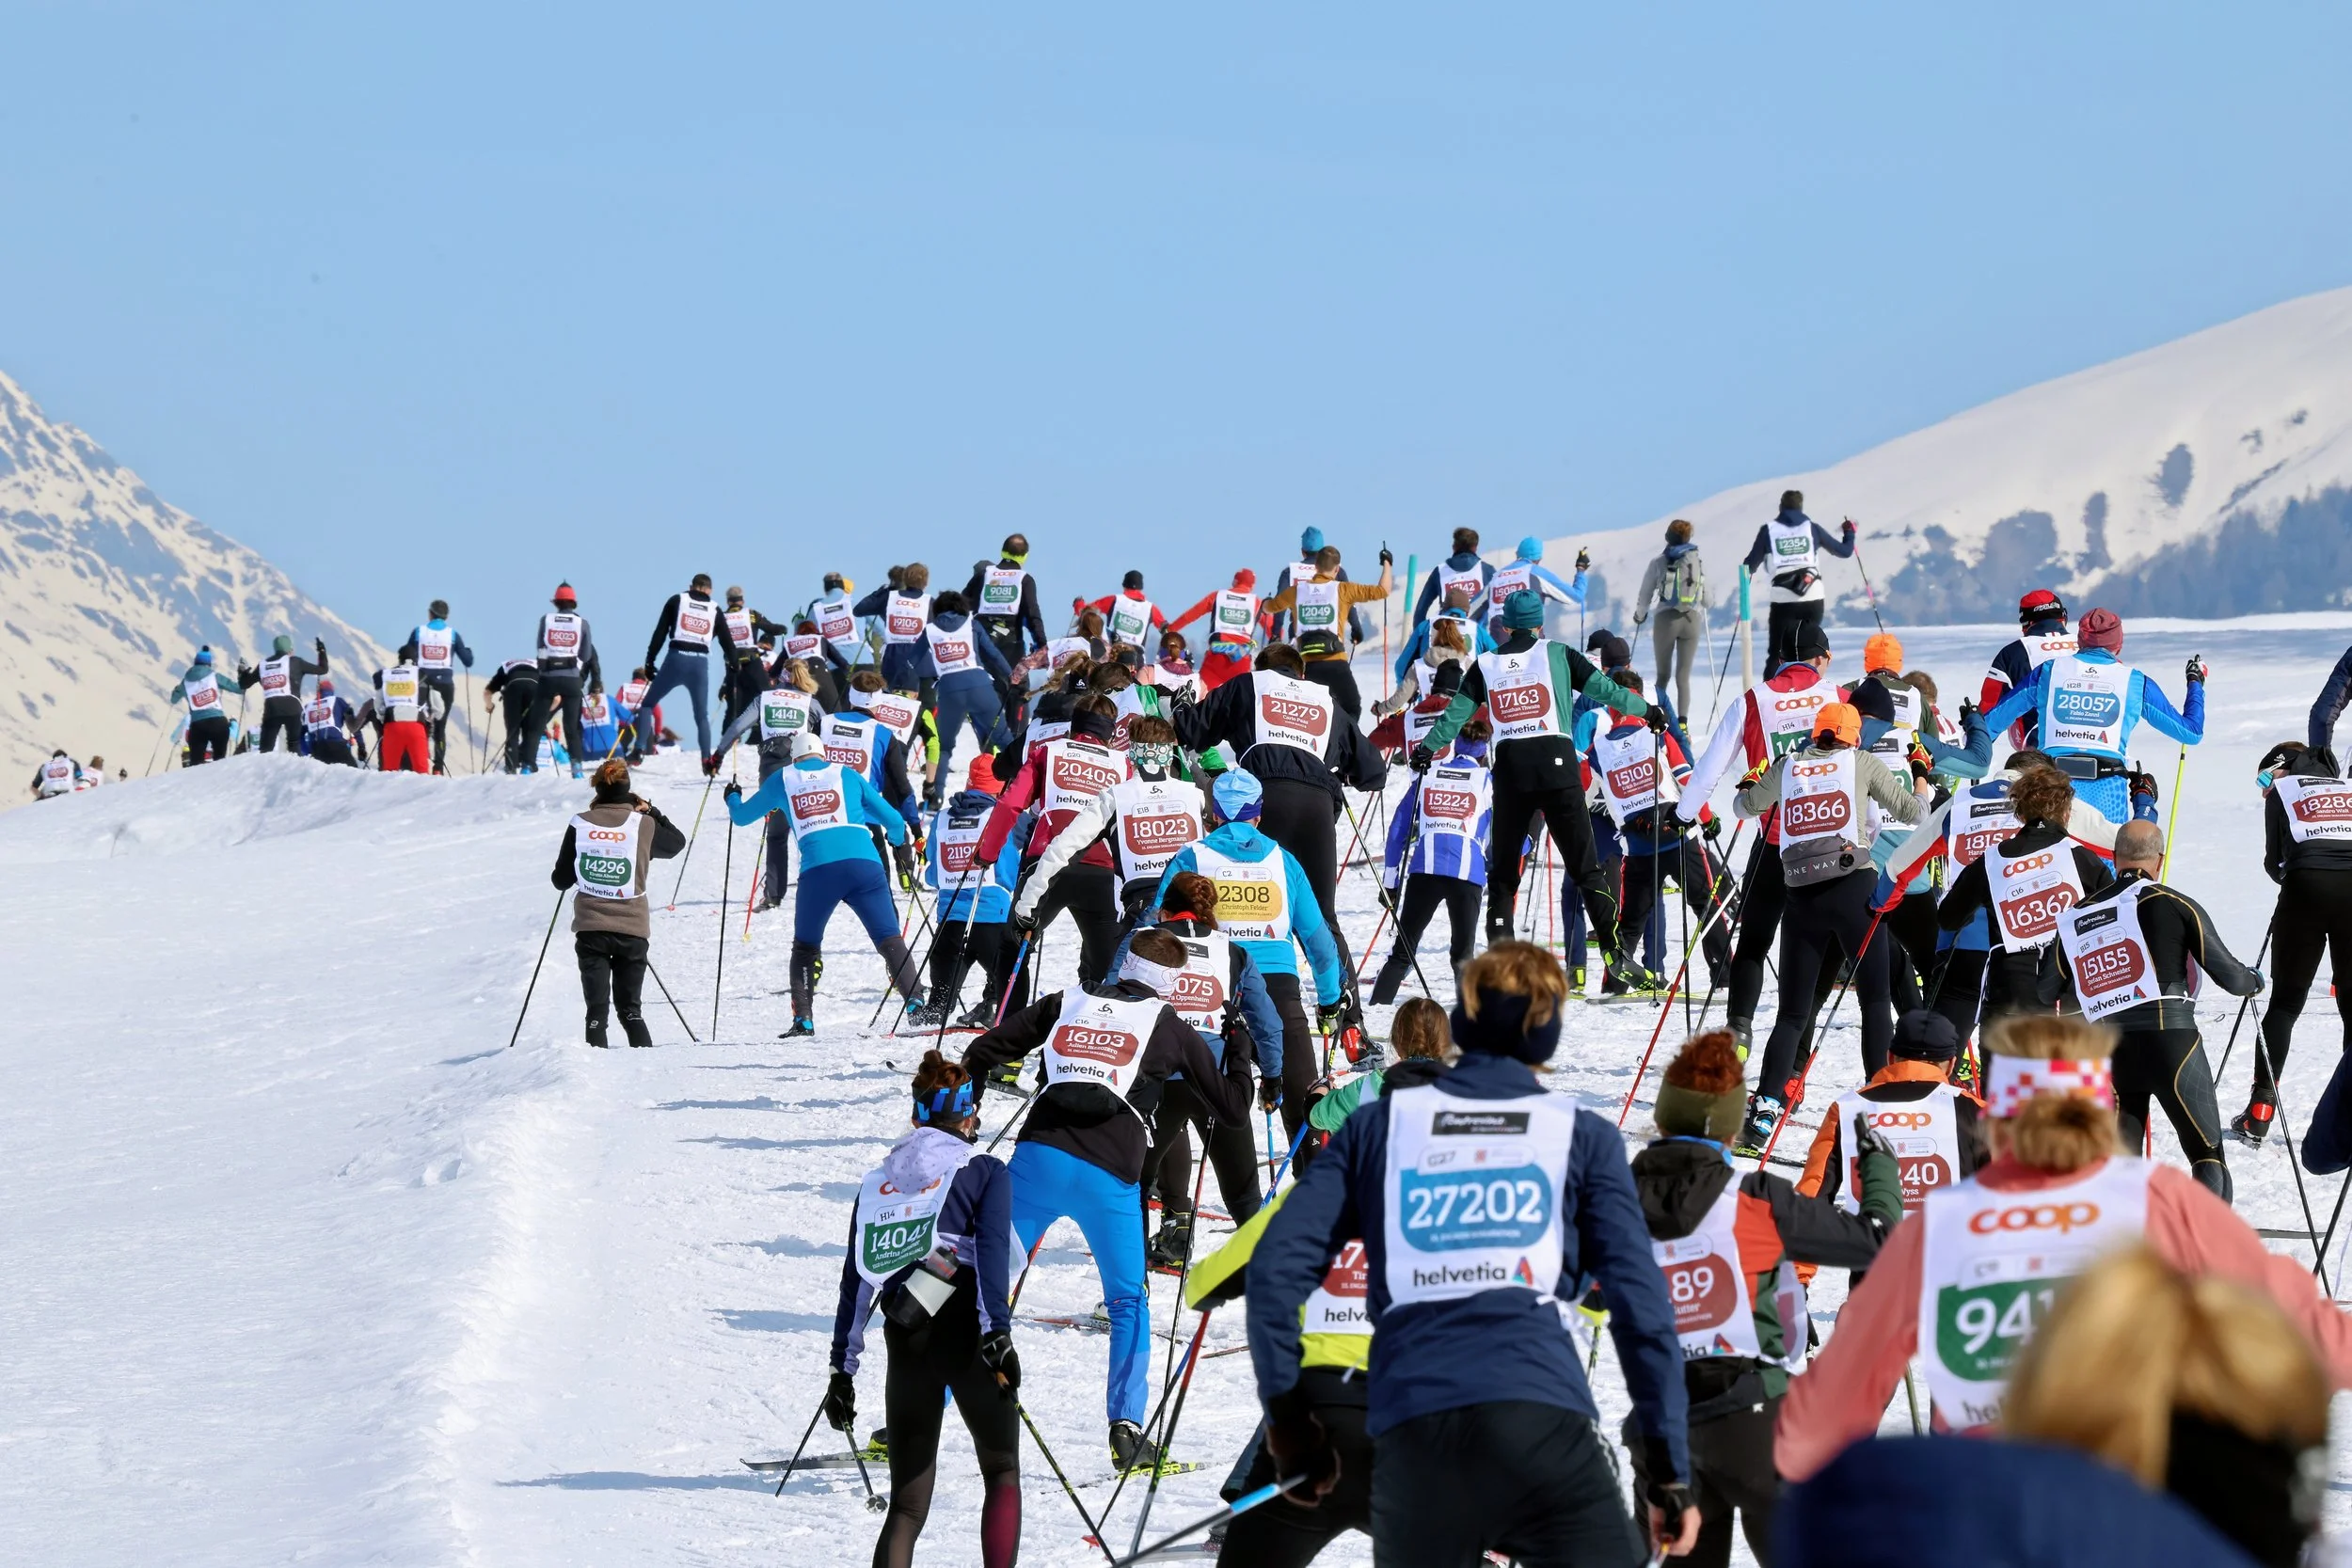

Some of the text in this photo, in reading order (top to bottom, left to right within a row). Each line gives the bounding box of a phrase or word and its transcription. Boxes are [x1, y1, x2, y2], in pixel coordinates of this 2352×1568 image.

[990, 586, 1012, 596] 9081
[1301, 607, 1331, 617] 12049
[685, 615, 708, 629] 18076
[893, 617, 919, 628] 19106
[937, 643, 966, 657] 16244
[1497, 689, 1540, 709] 17163
[1774, 695, 1824, 712] coop
[2058, 694, 2117, 713] 28057
[771, 707, 798, 720] 14141
[876, 705, 909, 721] 16253
[1270, 700, 1320, 721] 21279
[1501, 723, 1536, 736] helvetia
[2055, 729, 2096, 741] helvetia
[1268, 730, 1309, 746] helvetia
[825, 751, 863, 764] 18355
[1057, 761, 1117, 786] 20405
[1614, 763, 1654, 787] 15100
[1791, 763, 1838, 778] coop
[795, 793, 835, 810] 18099
[1056, 795, 1092, 806] helvet
[1428, 793, 1470, 808] 15224
[1621, 797, 1656, 812] helvetia
[1787, 798, 1846, 827] 18366
[1132, 818, 1188, 839] 18023
[1425, 821, 1457, 830] helvetia
[2305, 824, 2352, 837] helvetia
[588, 831, 627, 843] coop
[1136, 835, 1187, 846] Yvonne Bergmann
[1964, 832, 2016, 850] 1815
[584, 859, 626, 875] 14296
[1135, 859, 1169, 872] helvet
[1788, 860, 1836, 877] ONE WAY
[2003, 852, 2054, 879] coop
[583, 883, 614, 897] helvetia
[1218, 886, 1270, 903] 2308
[2007, 891, 2074, 930] 16362
[1223, 927, 1262, 938] elvetia
[2082, 946, 2130, 979] 15155
[2102, 966, 2132, 981] Schneider
[1177, 977, 1214, 996] 075
[1176, 995, 1210, 1004] Oppenheim
[2088, 994, 2131, 1015] helvetia
[1065, 1029, 1125, 1048] 16103
[1057, 1063, 1104, 1078] helvetia
[1867, 1113, 1931, 1131] coop
[1407, 1180, 1543, 1229] 27202
[1967, 1201, 2101, 1236] coop
[870, 1220, 931, 1253] 14045
[1414, 1262, 1506, 1288] helvetia
